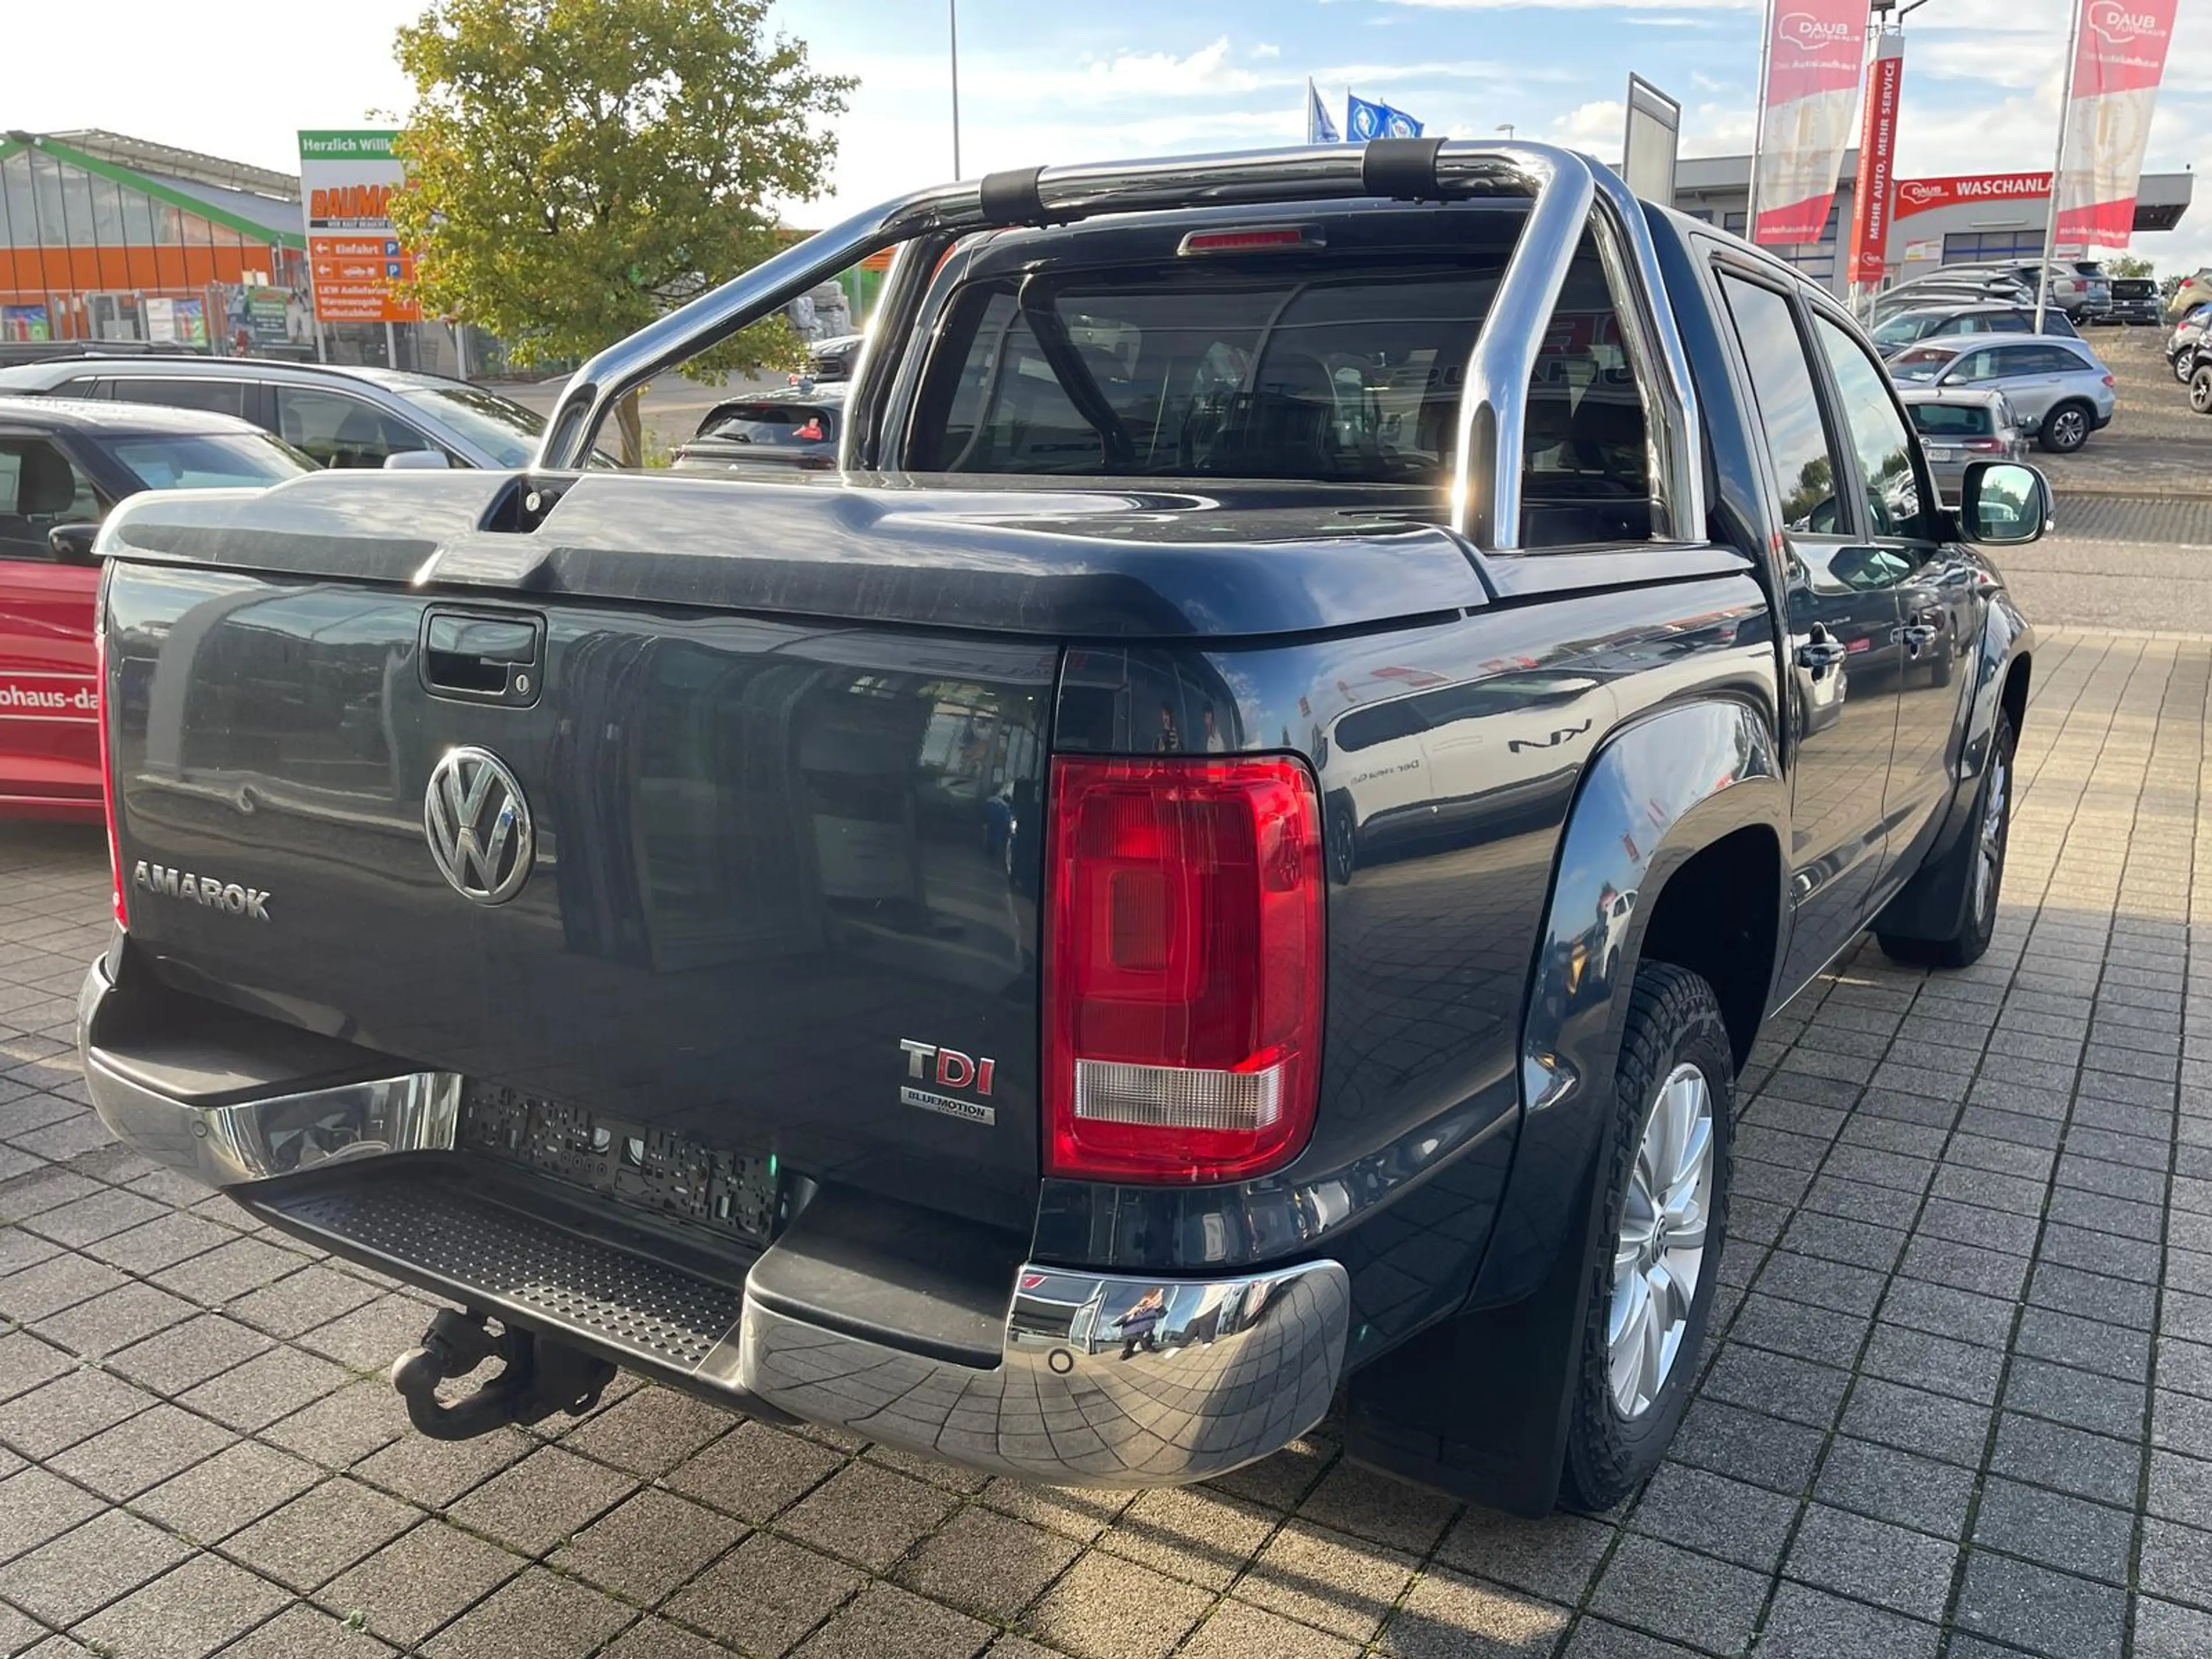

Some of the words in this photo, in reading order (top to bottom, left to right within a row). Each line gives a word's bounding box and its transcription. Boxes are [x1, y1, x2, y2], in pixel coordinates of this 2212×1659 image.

[1800, 22, 1848, 35] DAUB
[2107, 12, 2156, 28] DAUB
[1881, 60, 1895, 115] SERVICE
[303, 138, 357, 151] Herzlich
[1877, 119, 1890, 156] MEHR
[1873, 160, 1887, 199] AUTO,
[1869, 203, 1881, 240] MEHR
[335, 244, 378, 254] Einfahrt
[132, 860, 271, 922] AMAROK
[900, 1038, 995, 1096] TDI
[908, 1090, 986, 1116] BLUEMOTION
